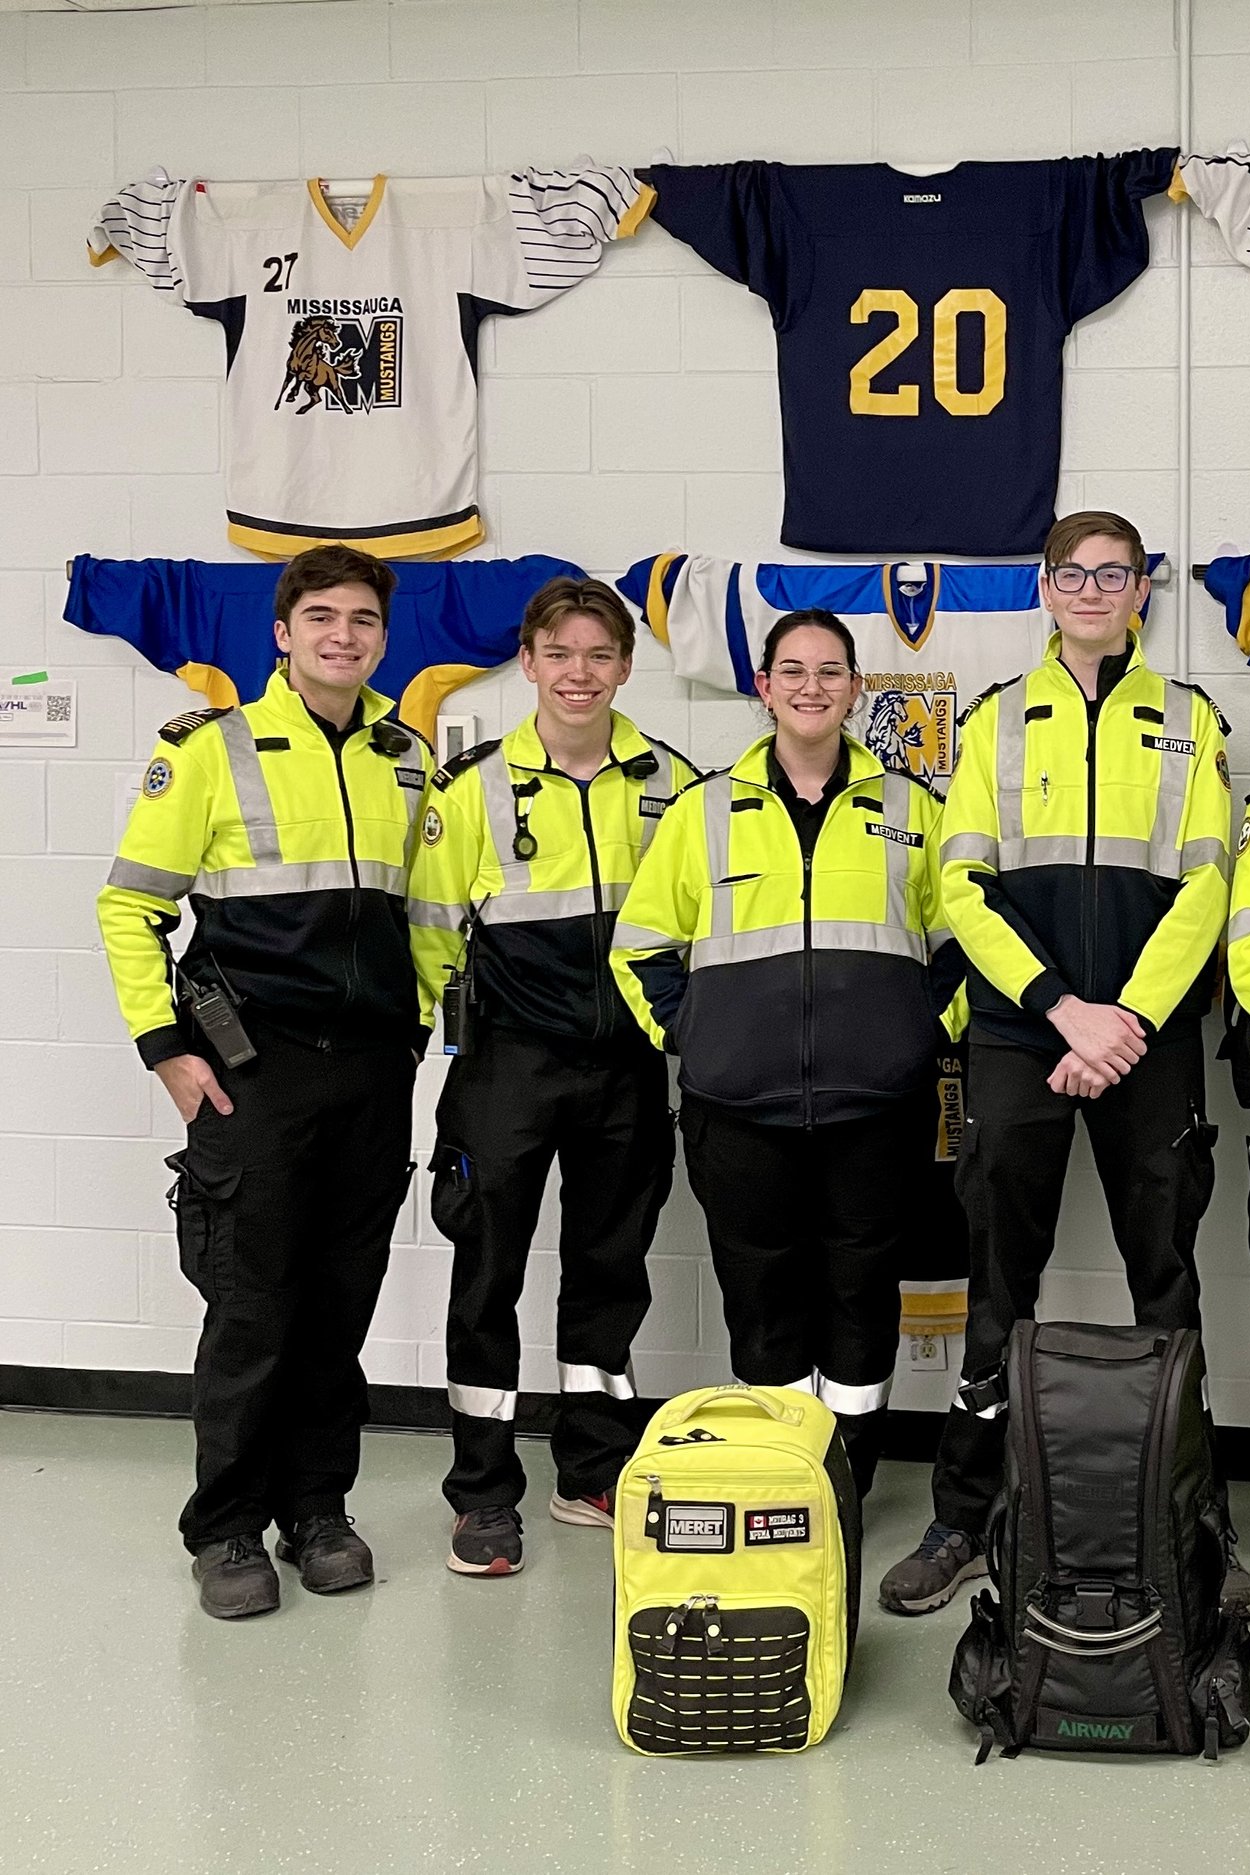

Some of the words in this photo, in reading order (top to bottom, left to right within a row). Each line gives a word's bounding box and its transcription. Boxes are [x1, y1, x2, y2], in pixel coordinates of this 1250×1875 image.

[263, 252, 298, 292] 27
[287, 297, 403, 315] MISSISSAUGA
[380, 322, 396, 400] MUSTANGS
[850, 288, 1007, 416] 20
[935, 699, 947, 770] MUSTANGS
[1154, 738, 1196, 754] MEDVEN
[641, 799, 667, 815] MEDIC
[871, 824, 918, 845] MEDVENT
[944, 1083, 963, 1156] MUSTANGS
[669, 1520, 723, 1535] MERET
[799, 1513, 805, 1524] 3
[1057, 1719, 1135, 1739] AIRWAY
